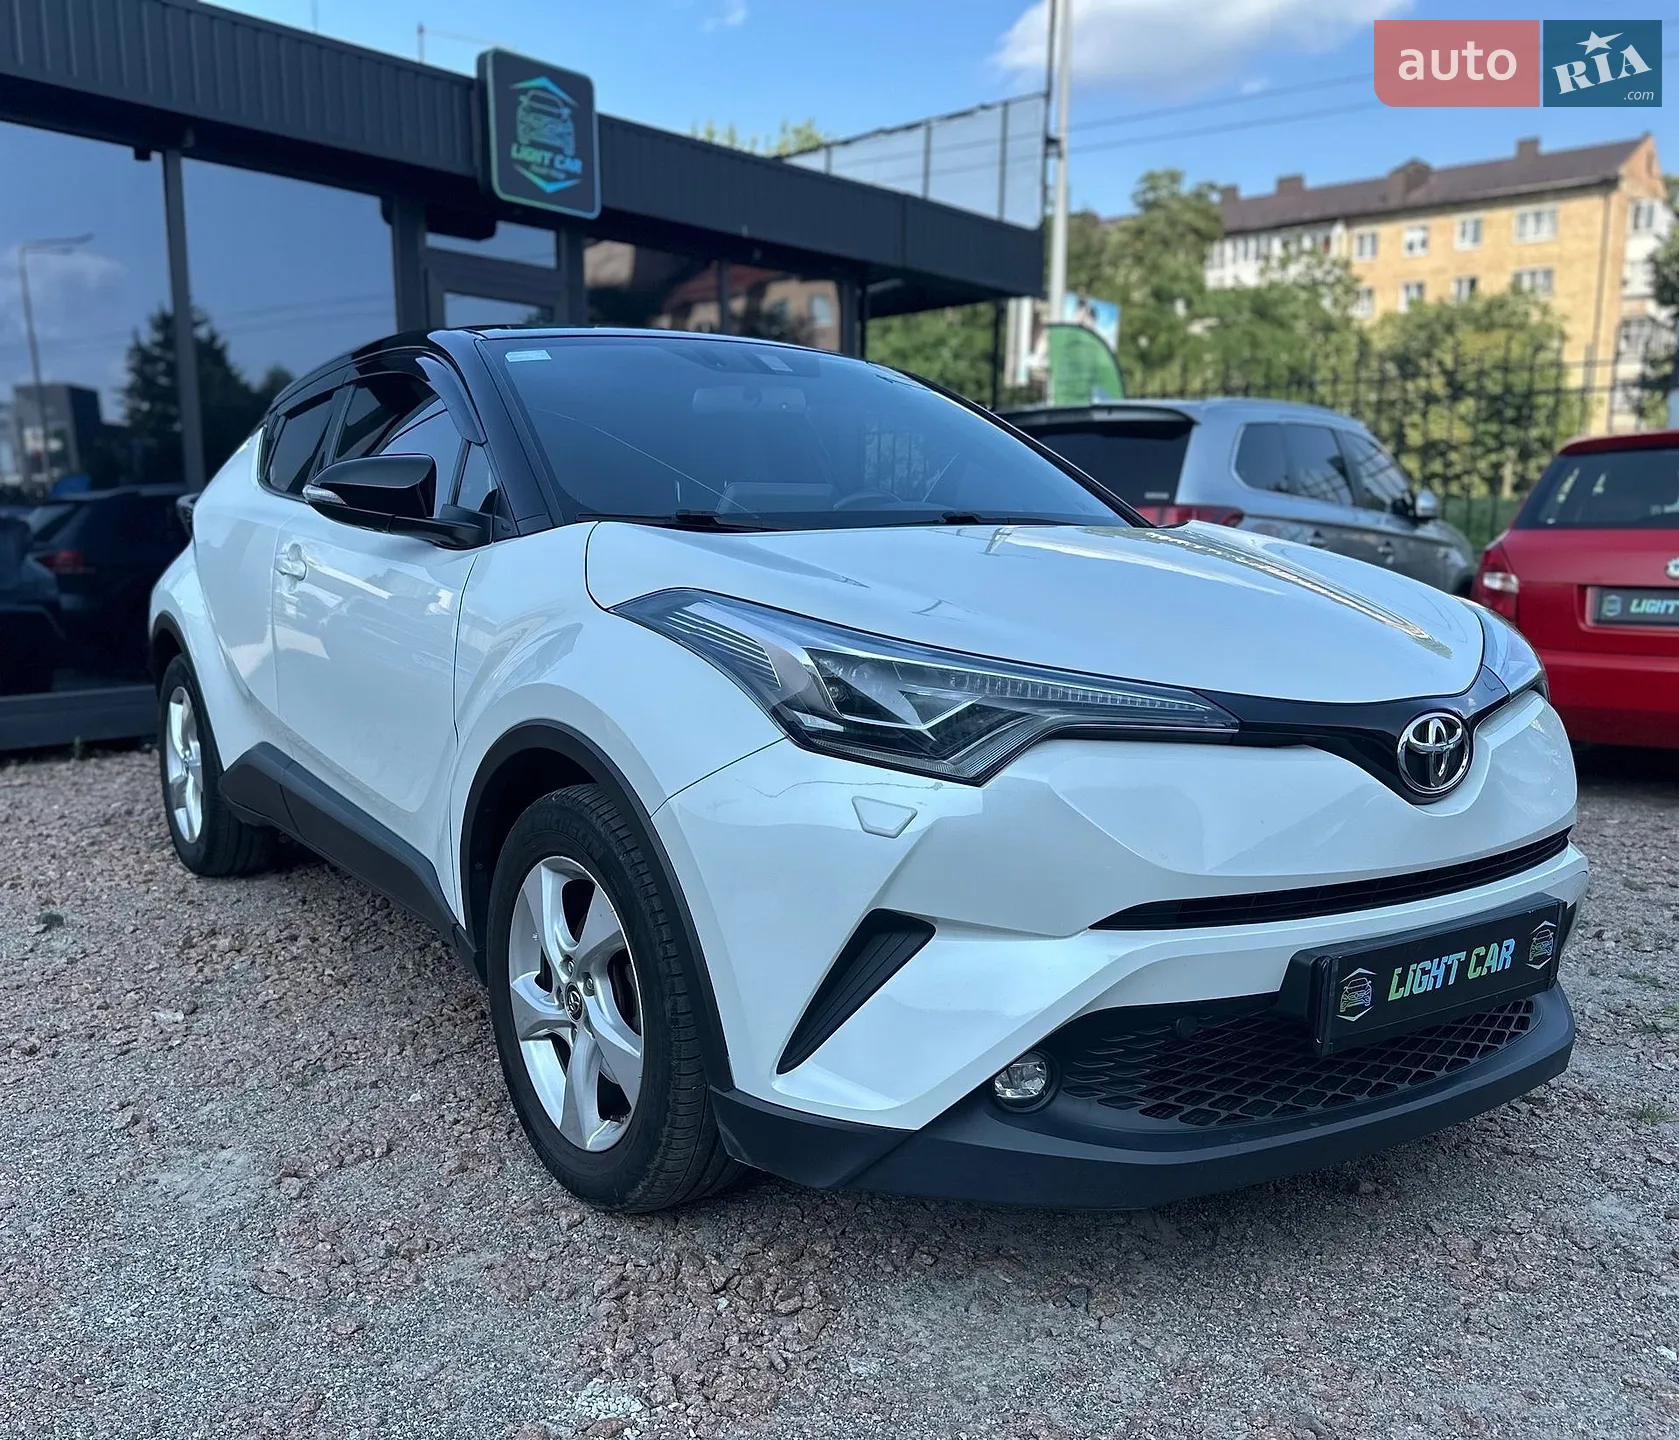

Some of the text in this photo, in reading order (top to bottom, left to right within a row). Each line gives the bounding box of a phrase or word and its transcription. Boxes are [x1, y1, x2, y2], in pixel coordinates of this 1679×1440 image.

[511, 142, 553, 166] LIGHT
[554, 154, 583, 175] CAR
[1630, 598, 1679, 615] LIGHT
[1387, 938, 1516, 1002] LIGHT CAR
